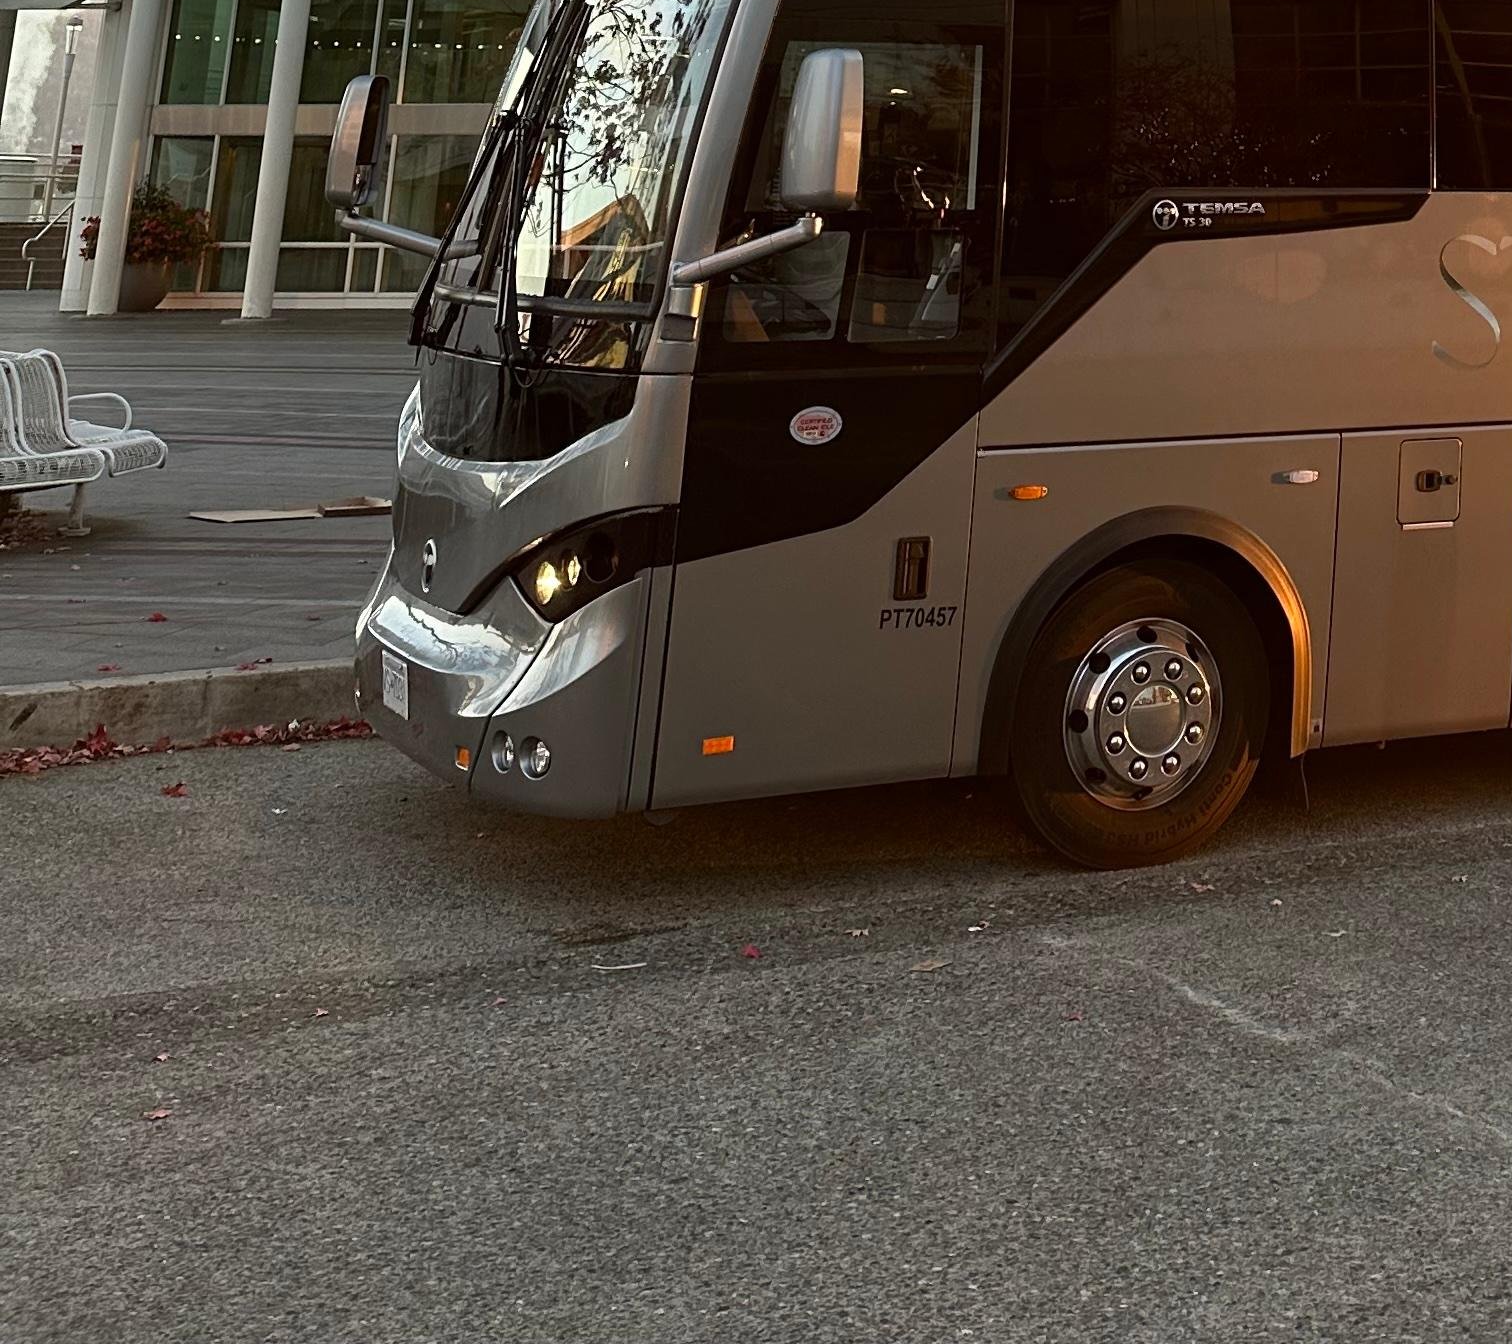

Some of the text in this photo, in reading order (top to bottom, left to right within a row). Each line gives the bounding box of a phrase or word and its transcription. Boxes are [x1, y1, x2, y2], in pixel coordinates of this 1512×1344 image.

[1182, 202, 1266, 214] TEMSA
[1182, 217, 1212, 228] TS 30
[878, 606, 958, 630] PT70457
